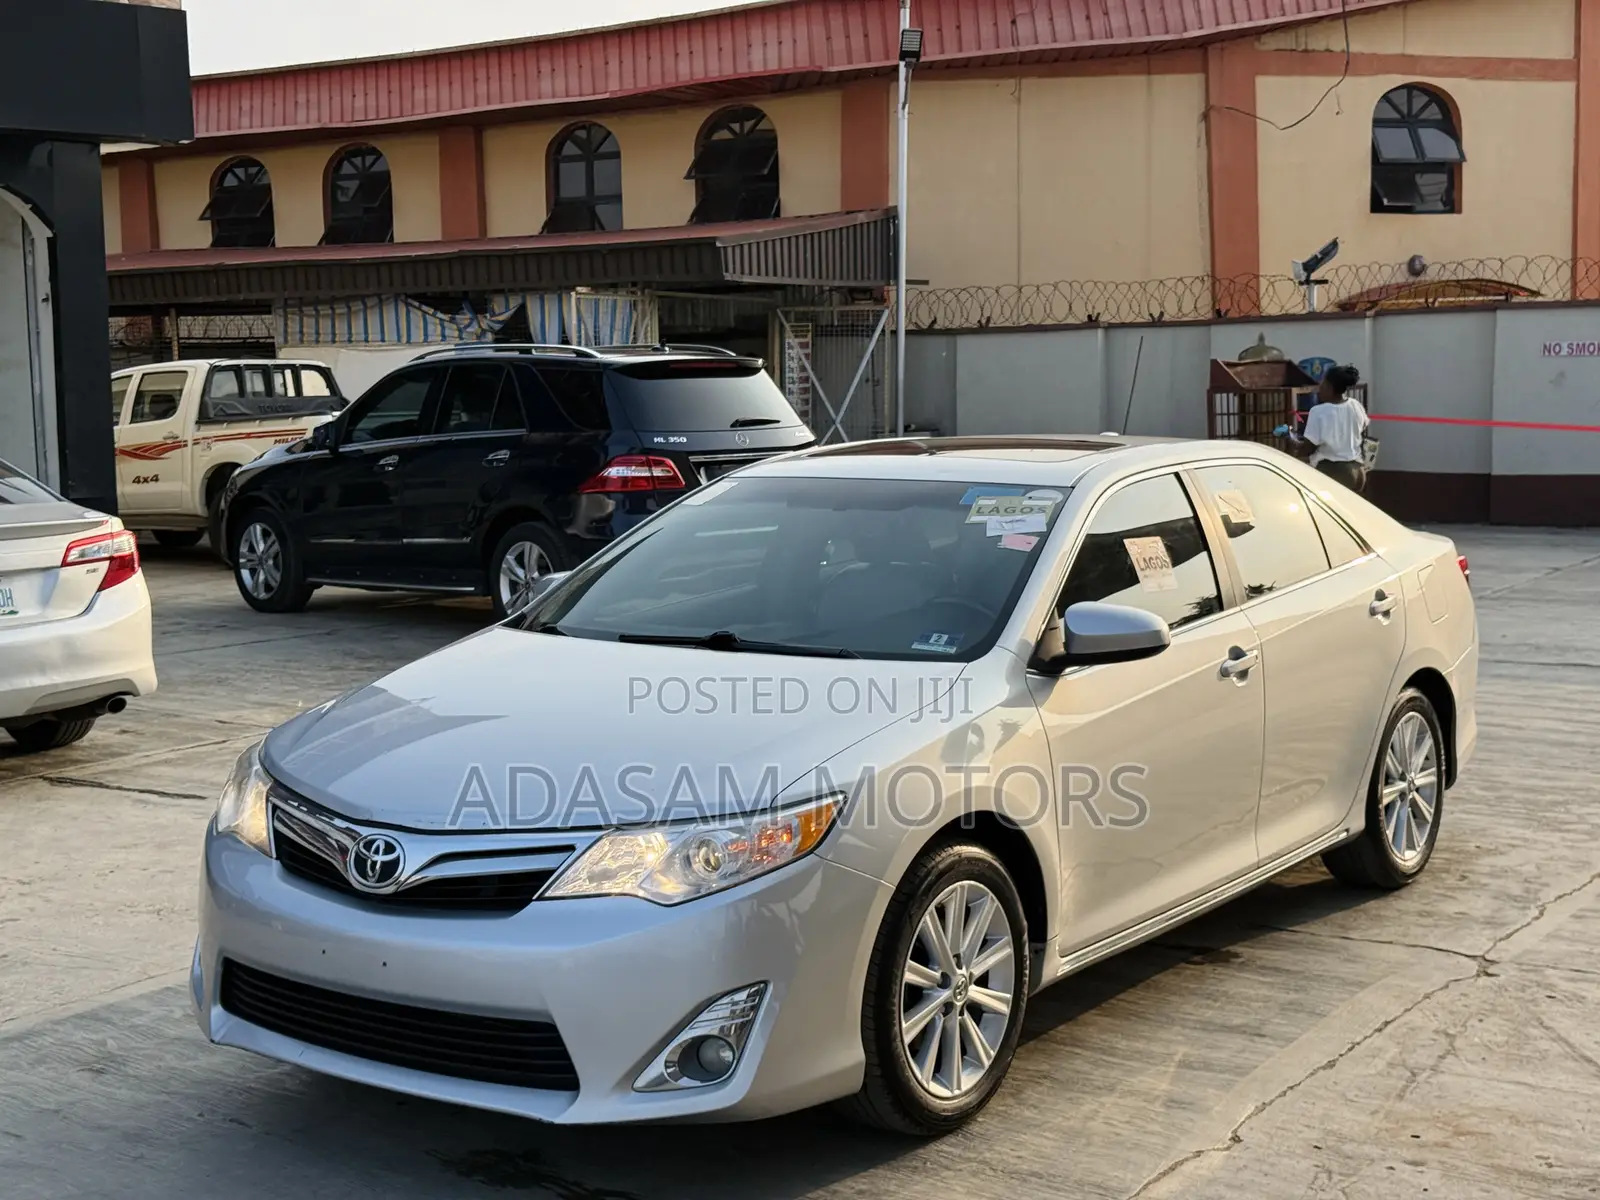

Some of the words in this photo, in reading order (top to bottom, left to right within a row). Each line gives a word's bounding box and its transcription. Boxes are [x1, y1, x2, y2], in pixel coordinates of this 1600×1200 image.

[1542, 342, 1562, 356] NO
[132, 473, 160, 485] 4x4
[975, 506, 1047, 514] LAGOS
[1135, 555, 1170, 571] LAGOS
